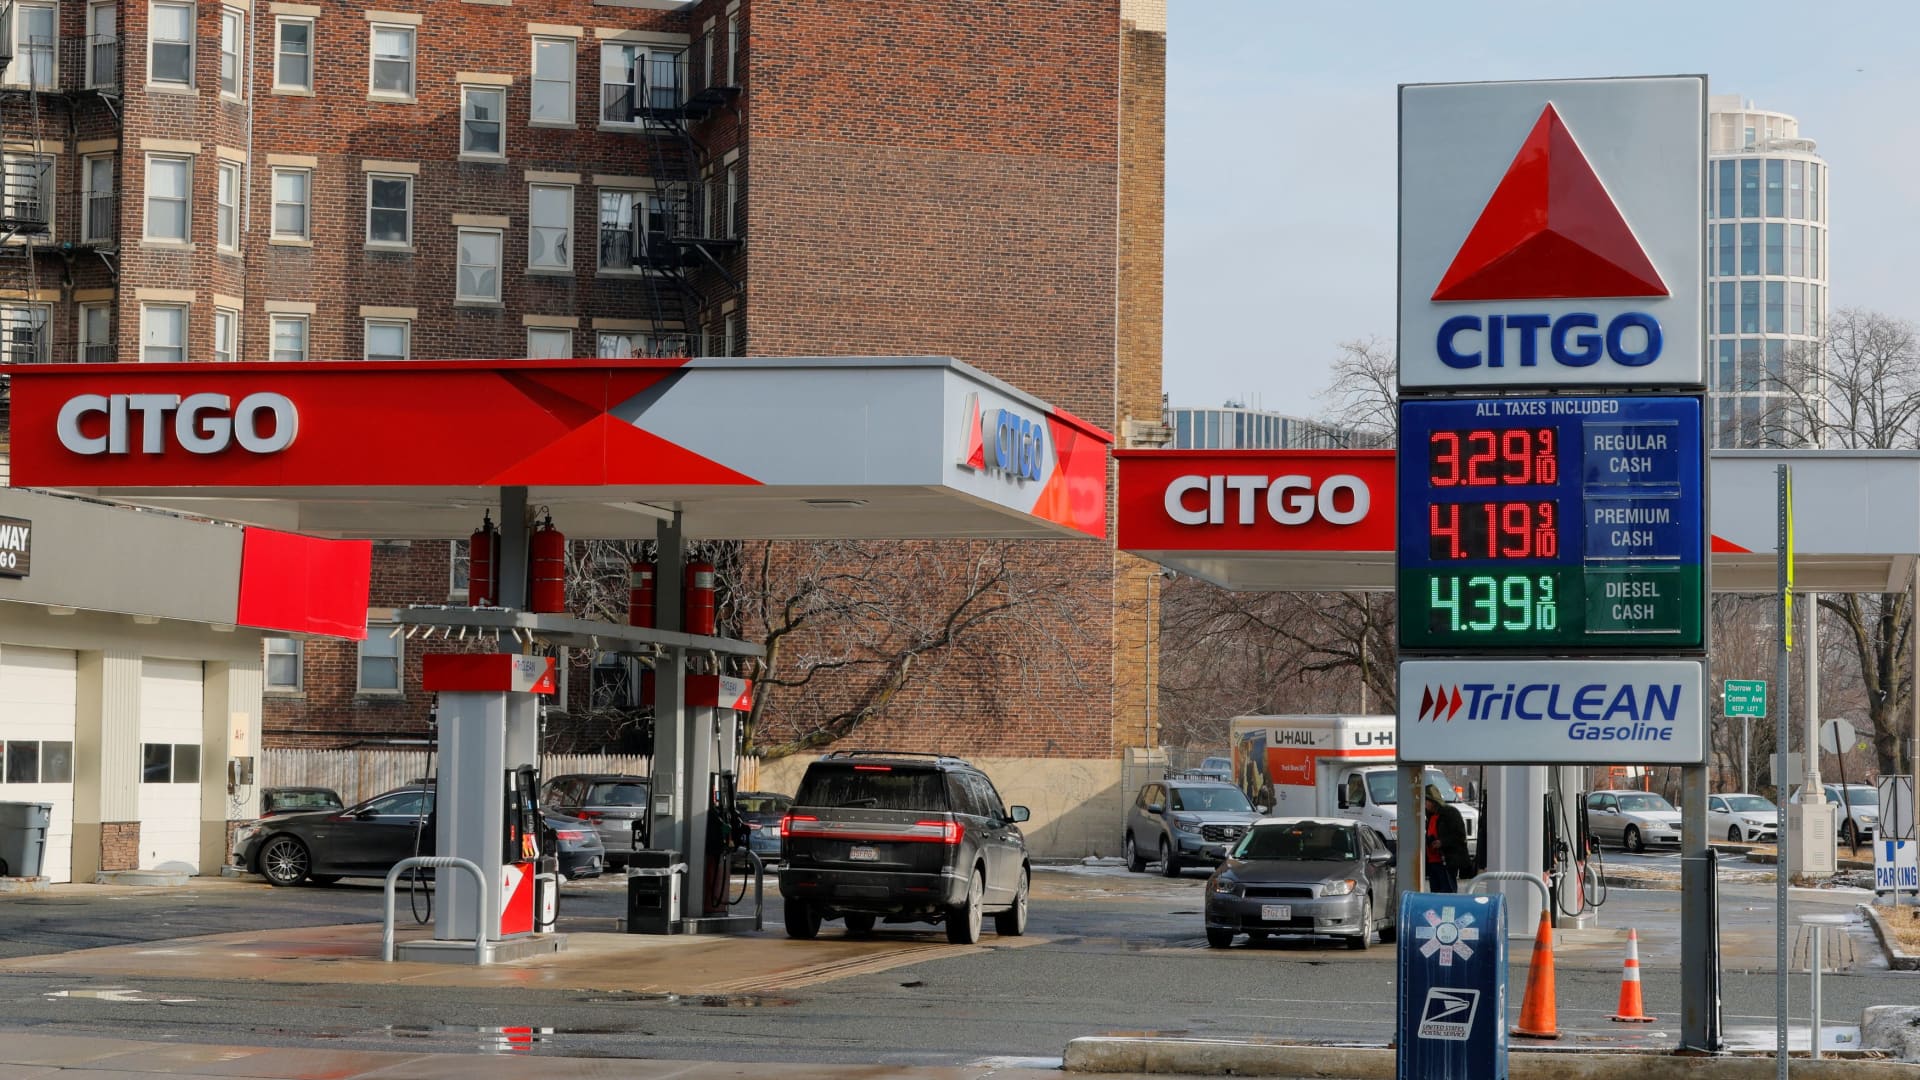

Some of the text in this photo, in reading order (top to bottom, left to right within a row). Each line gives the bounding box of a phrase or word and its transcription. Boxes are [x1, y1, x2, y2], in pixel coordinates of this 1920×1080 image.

[1437, 312, 1664, 369] CITGO
[1475, 400, 1619, 417] ALL TAXES INCLUDED
[57, 391, 299, 455] CITGO
[994, 408, 1043, 482] CITGO
[1594, 434, 1667, 451] REGULAR
[1431, 430, 1531, 486] 3.29
[1609, 456, 1652, 473] CASH
[1165, 474, 1370, 525] CITGO
[1594, 508, 1670, 524] PREMIUM
[1431, 503, 1531, 558] 4.19
[1611, 530, 1653, 546] CASH
[1605, 582, 1660, 598] DIESEL
[1431, 576, 1531, 631] 4.39
[1612, 604, 1654, 620] CASH
[1728, 684, 1763, 692] Storrow Dr
[1462, 683, 1682, 721] TriCLEAN
[1728, 694, 1762, 703] Comm Ave
[235, 729, 245, 740] Air
[1568, 722, 1673, 741] Gasoline
